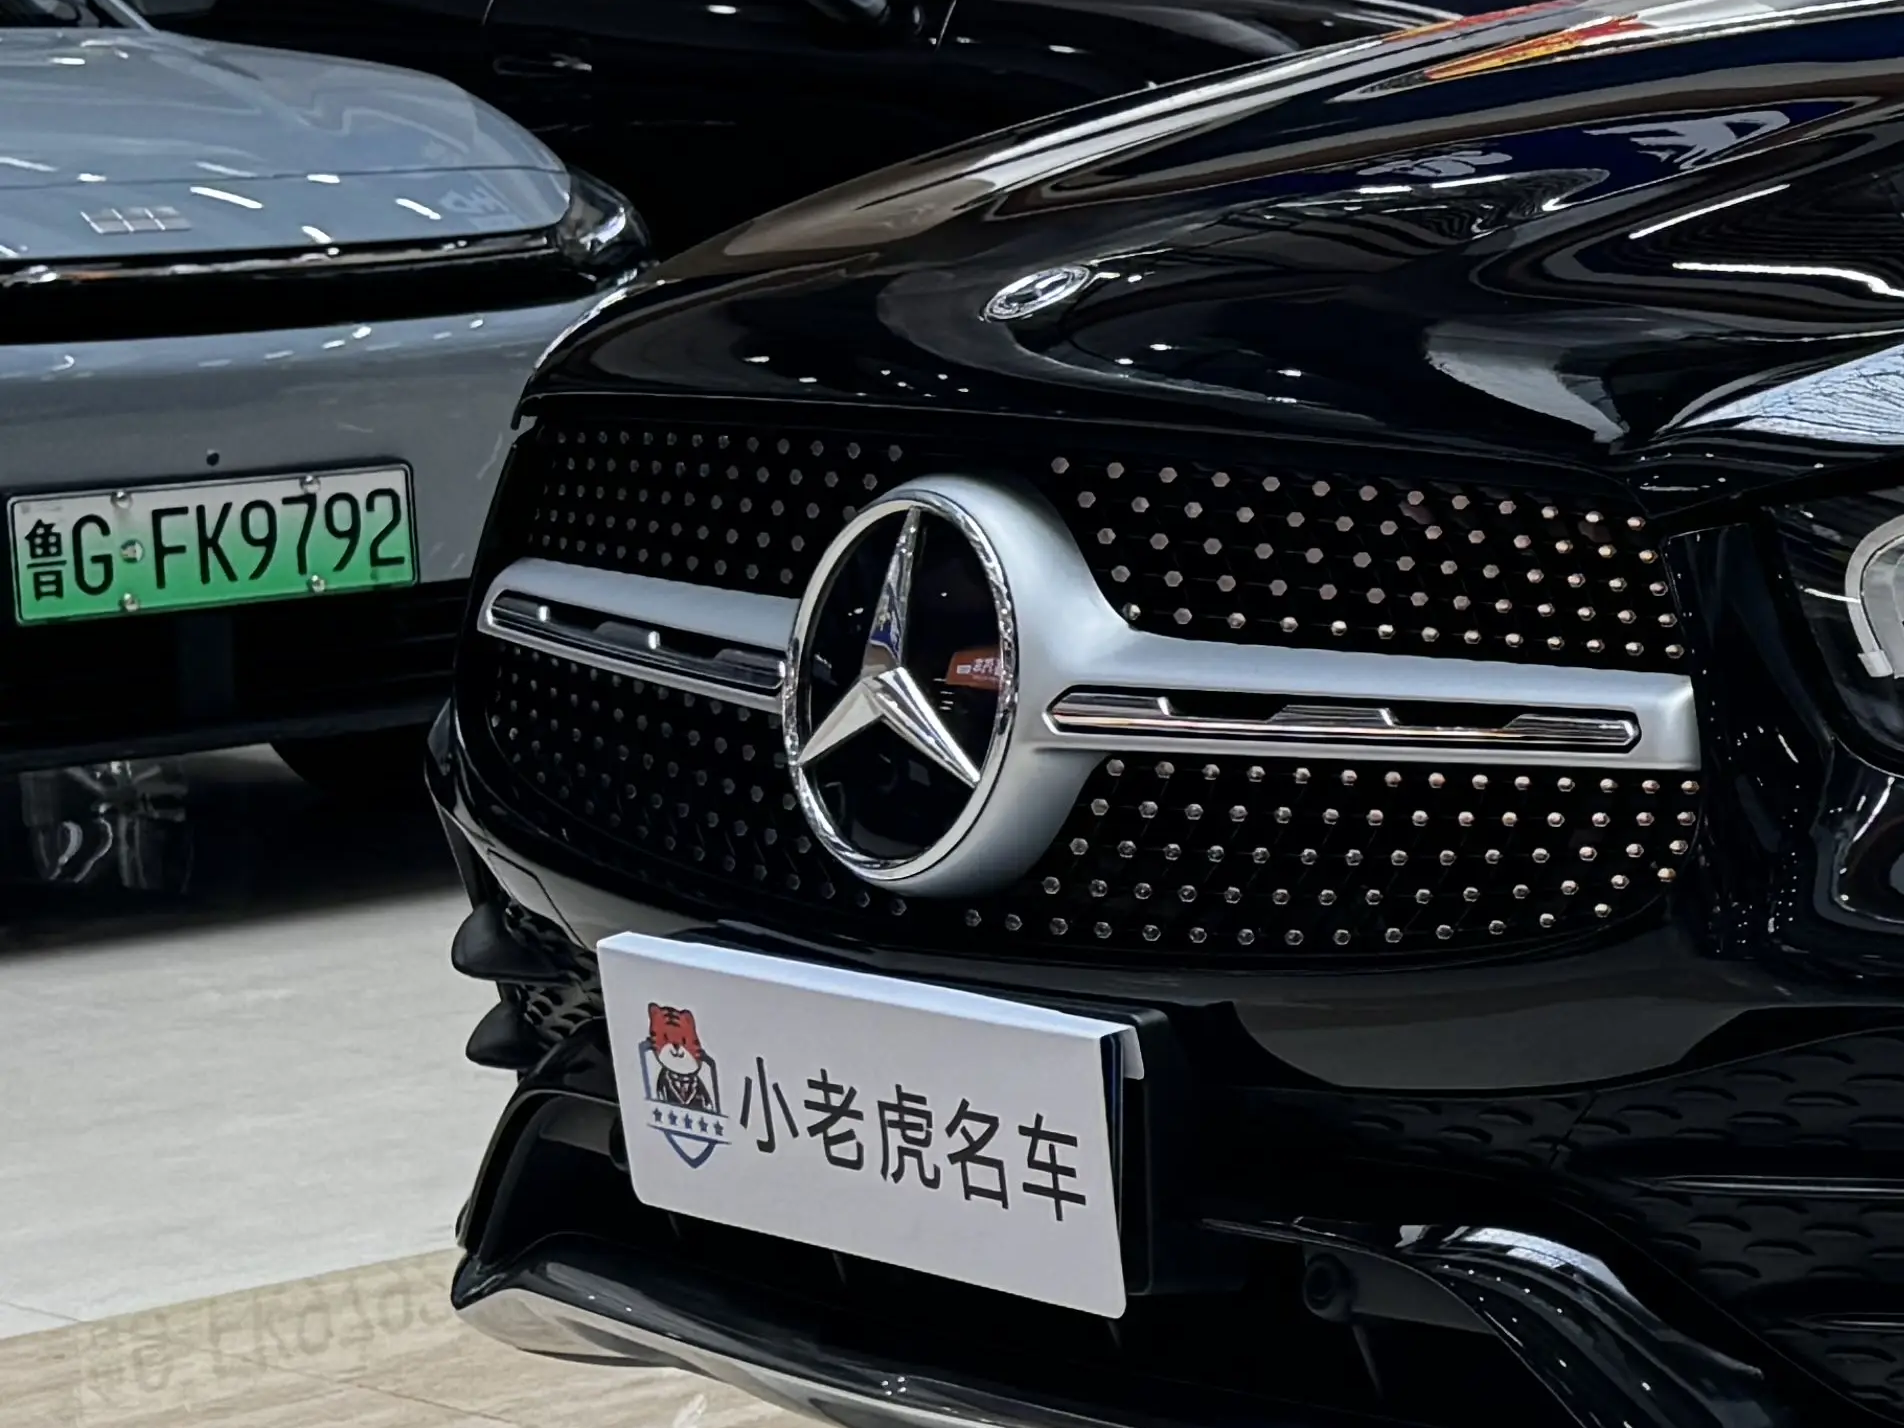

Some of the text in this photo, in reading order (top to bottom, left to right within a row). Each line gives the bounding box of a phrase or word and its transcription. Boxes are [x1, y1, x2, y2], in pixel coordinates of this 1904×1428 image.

[739, 1056, 1087, 1222] 小老虎名车
